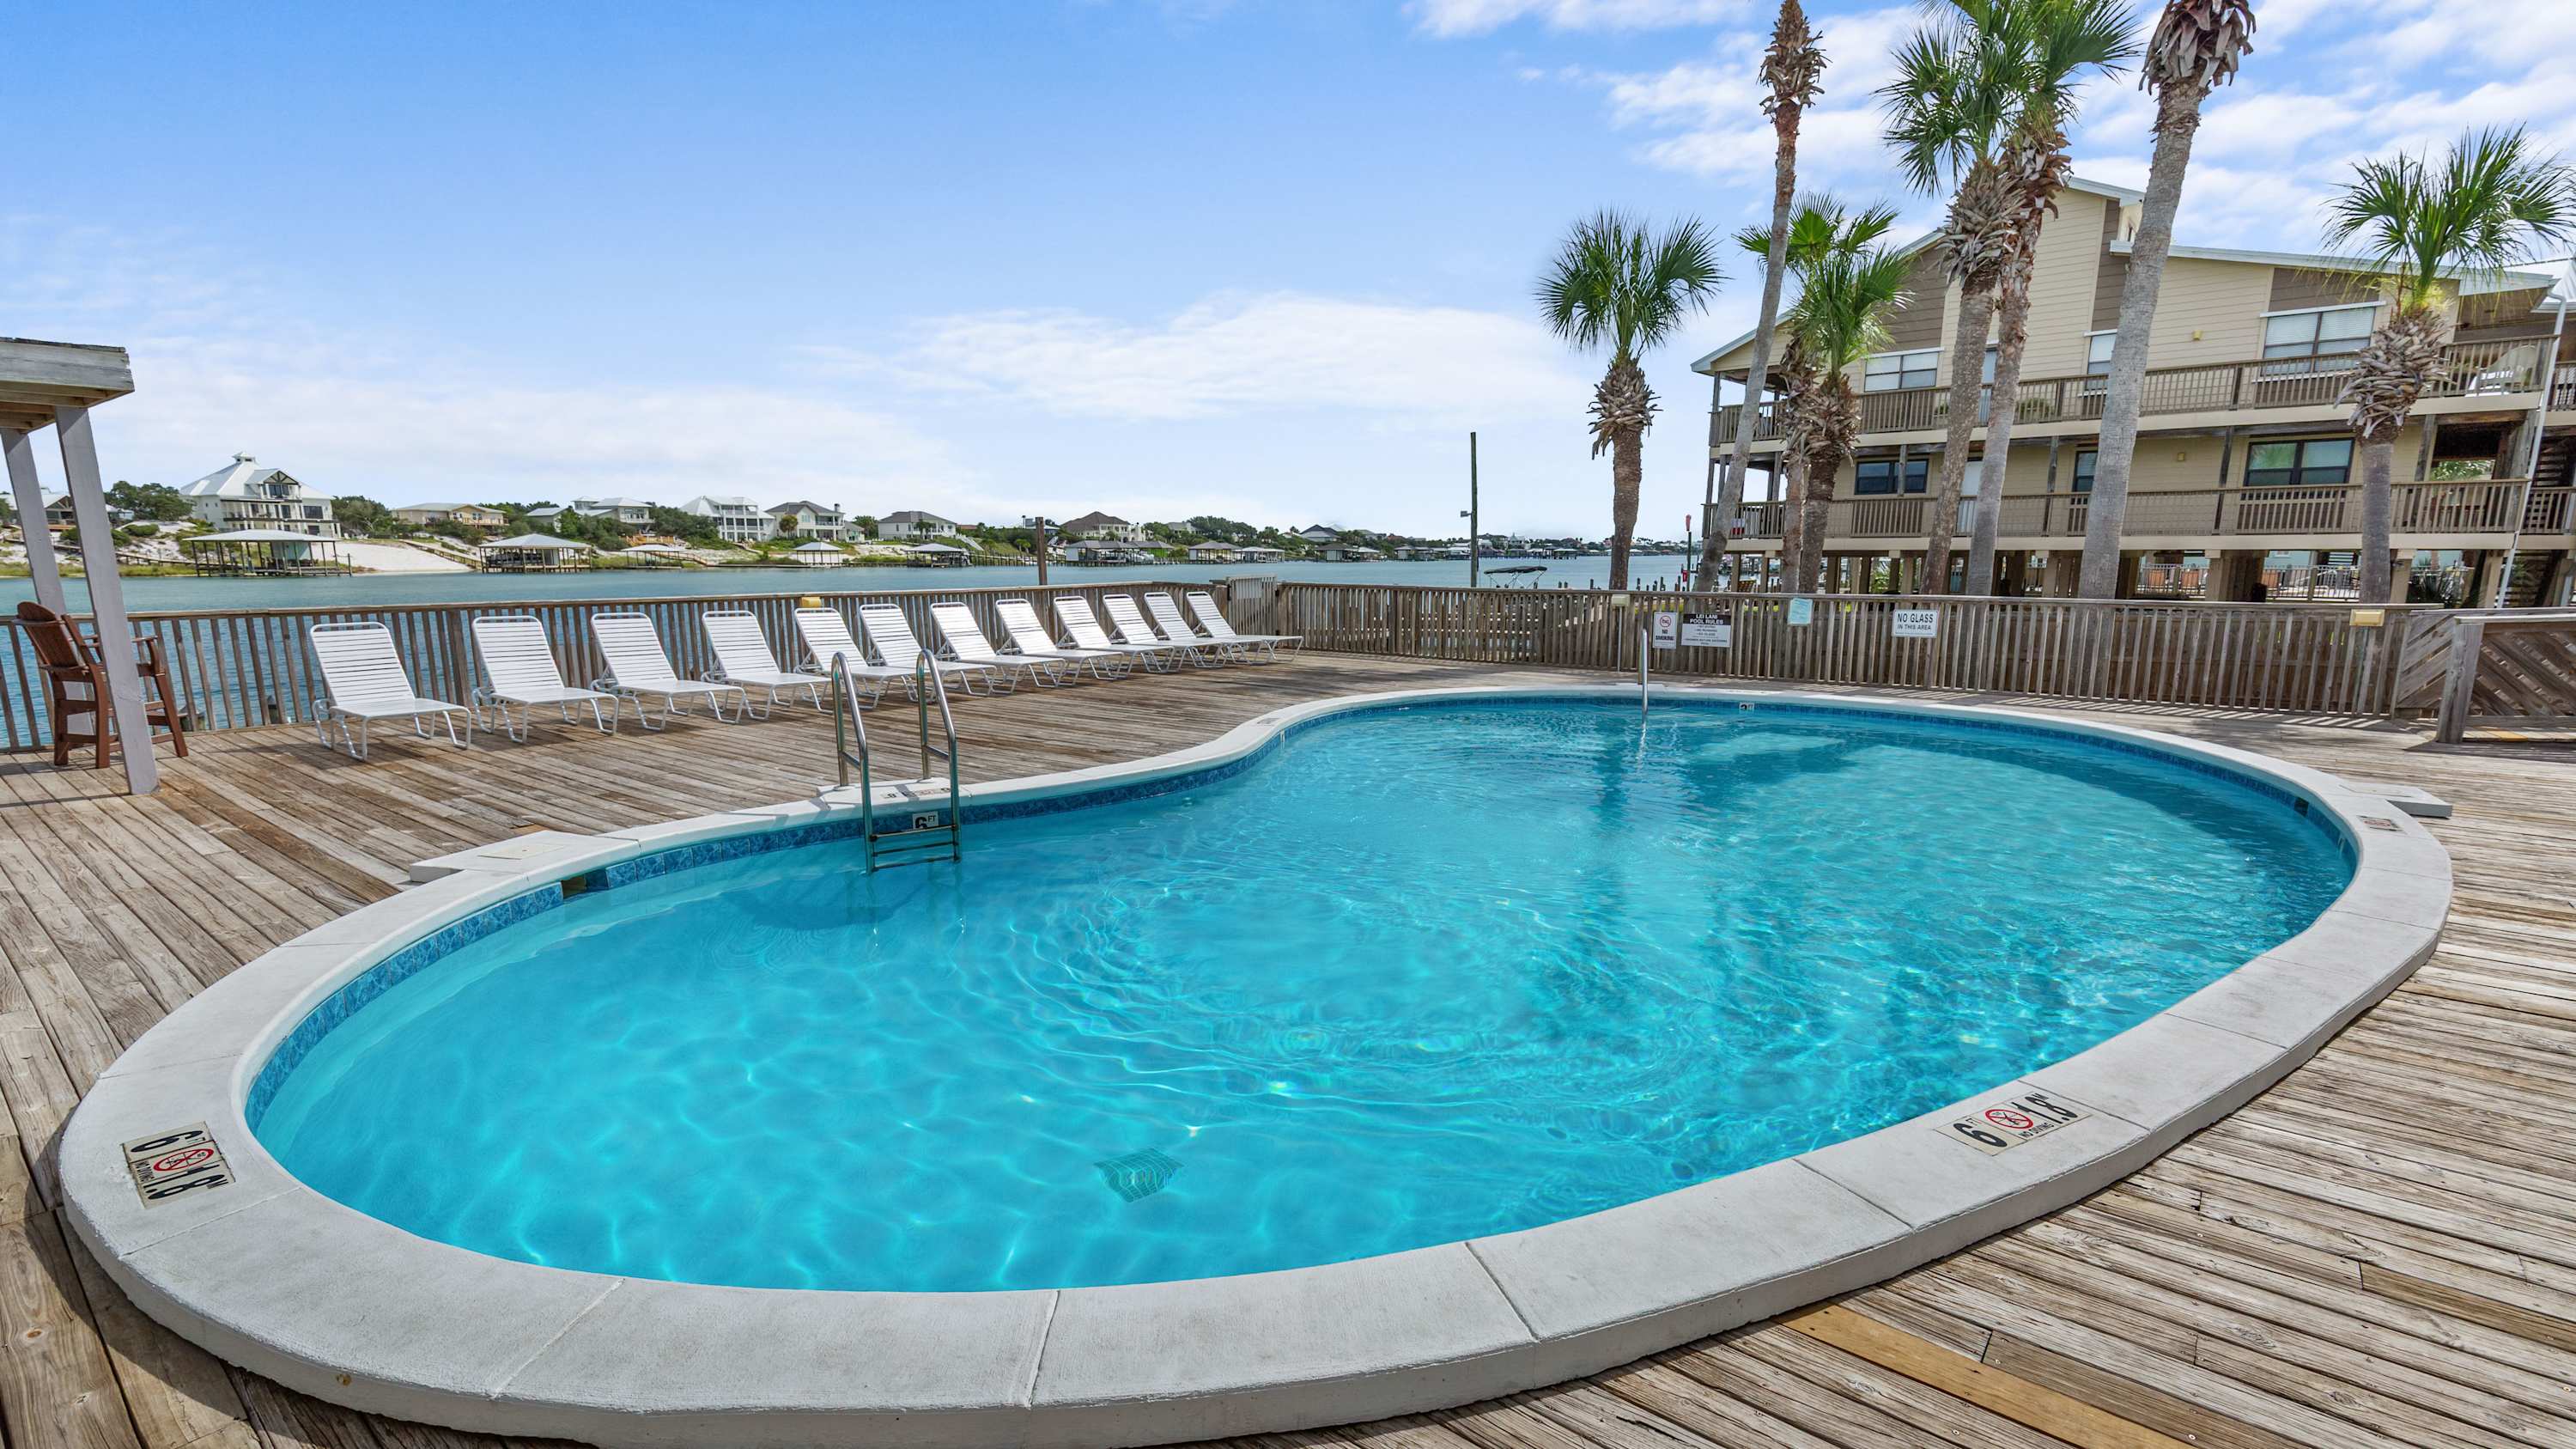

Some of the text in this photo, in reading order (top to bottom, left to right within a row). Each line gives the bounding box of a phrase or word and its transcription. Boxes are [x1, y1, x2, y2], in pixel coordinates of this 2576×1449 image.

[1898, 613, 1934, 623] NO GLASS
[915, 817, 928, 830] 6
[2011, 1096, 2078, 1124] 1.8
[131, 1130, 204, 1153] 6
[1953, 1123, 2008, 1148] 6
[143, 1164, 225, 1200] 1.8
